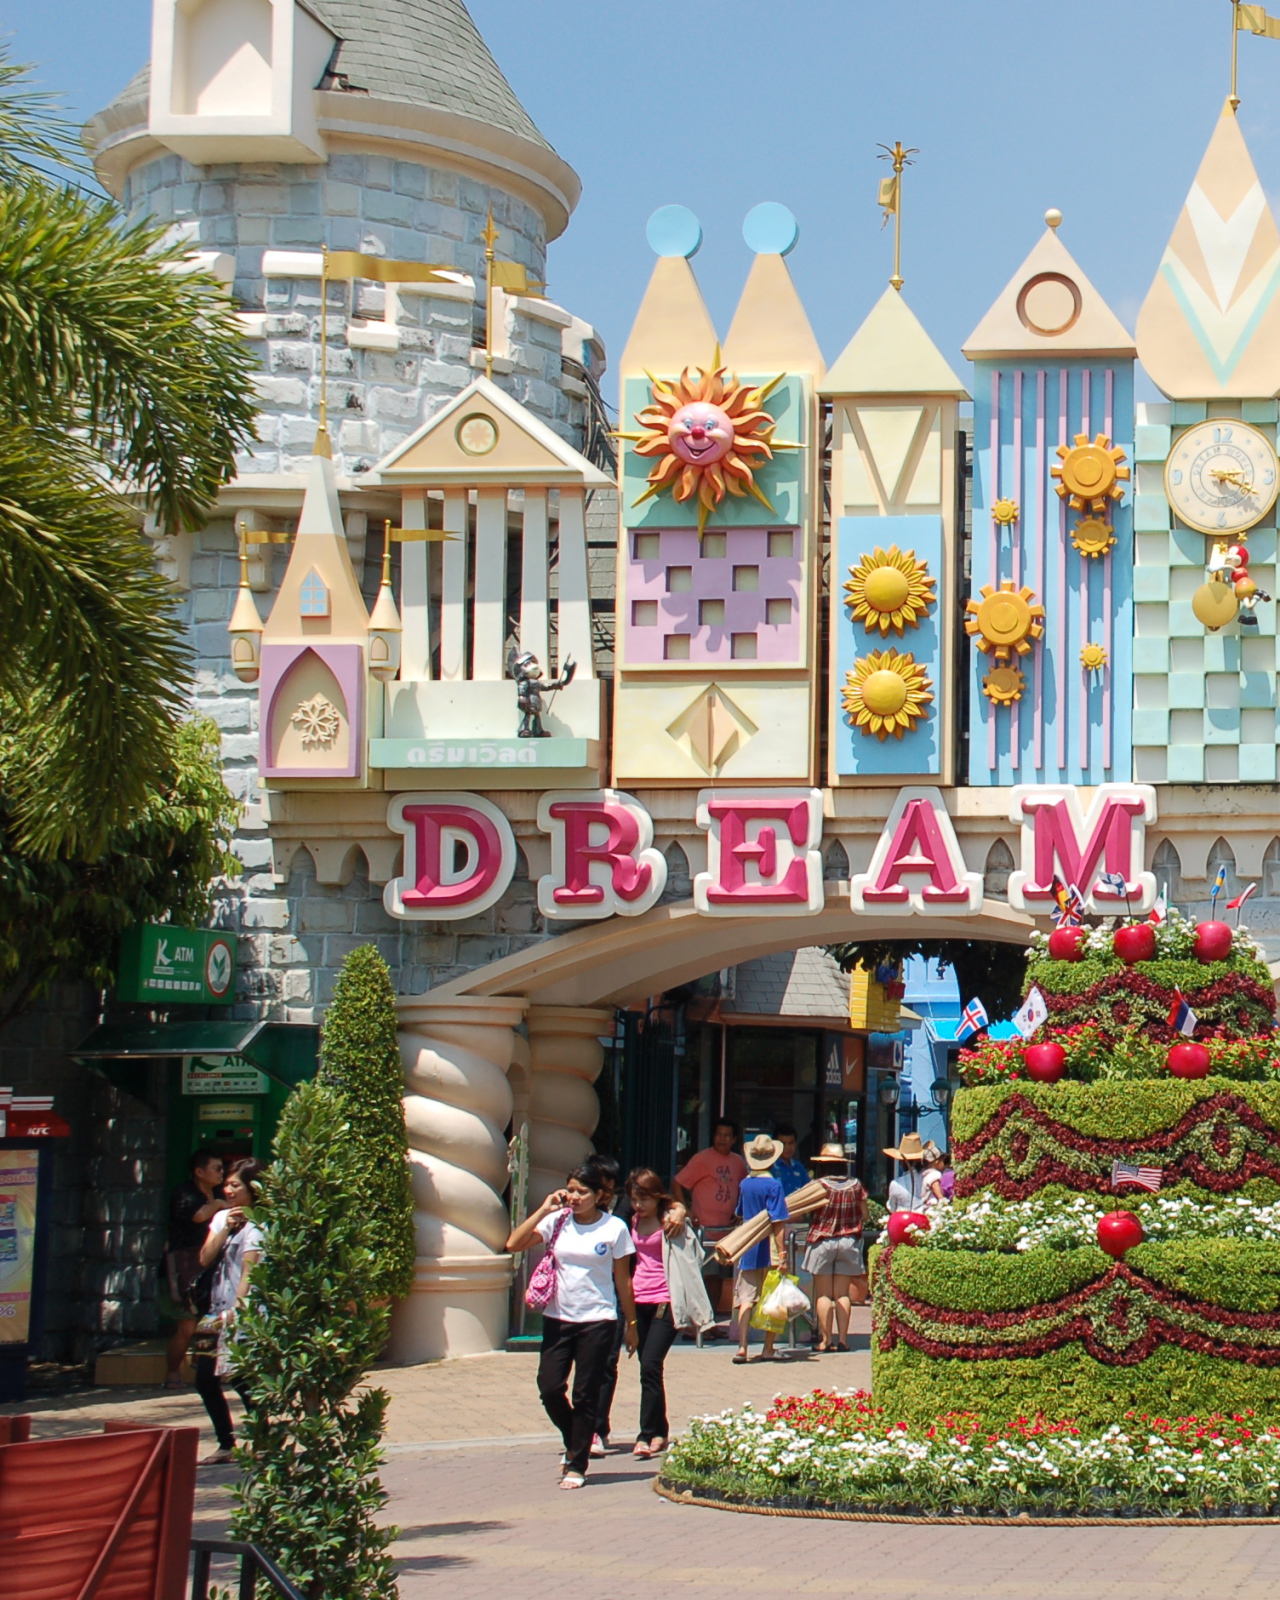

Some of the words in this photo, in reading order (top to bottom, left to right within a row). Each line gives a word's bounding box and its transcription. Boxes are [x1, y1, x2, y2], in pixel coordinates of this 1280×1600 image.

[1212, 427, 1233, 443] 12
[1172, 469, 1183, 486] 9
[1263, 468, 1274, 485] 3
[1216, 511, 1227, 527] 6
[384, 783, 1157, 920] DREAM
[156, 938, 172, 966] K
[174, 947, 194, 962] ATM
[27, 1127, 51, 1136] KFC
